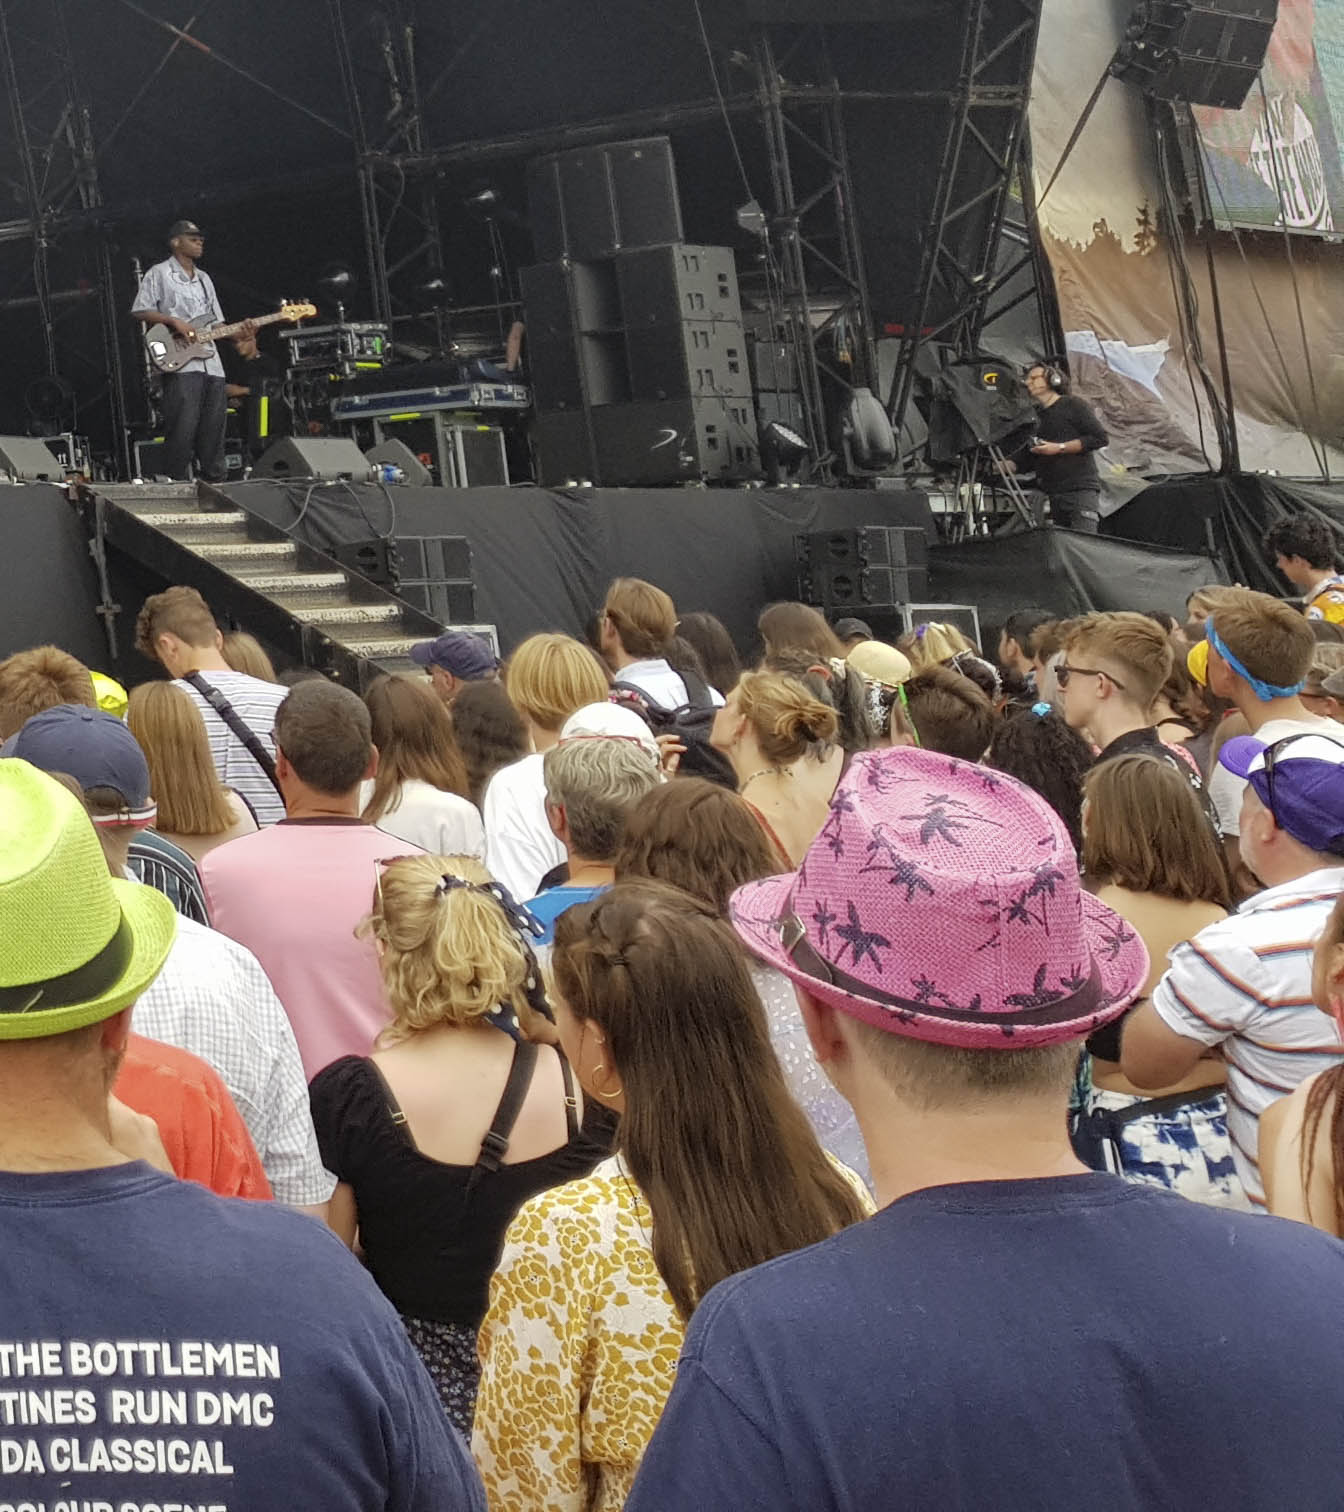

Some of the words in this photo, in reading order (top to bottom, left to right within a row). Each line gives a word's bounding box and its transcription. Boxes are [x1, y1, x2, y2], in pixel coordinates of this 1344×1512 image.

[69, 1341, 281, 1379] BOTTLEMEN
[112, 1390, 188, 1425] RUN
[196, 1391, 275, 1427] DMC
[49, 1438, 235, 1474] CLASSICAL
